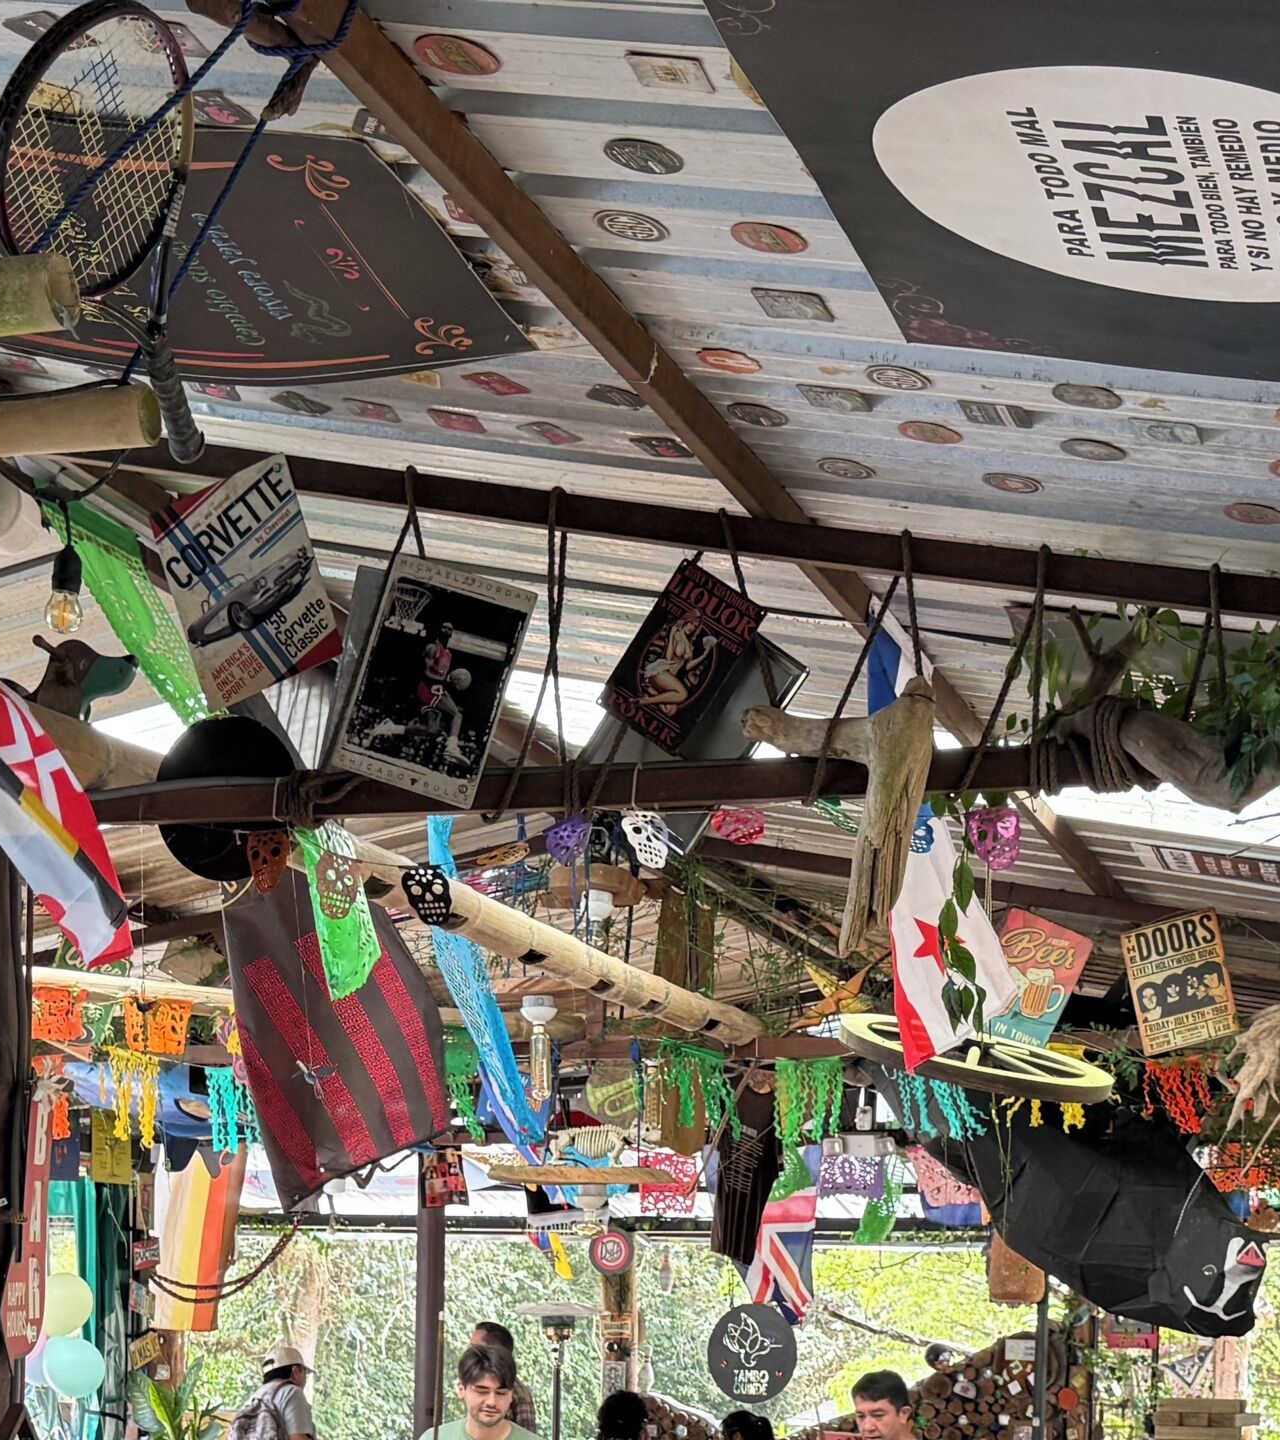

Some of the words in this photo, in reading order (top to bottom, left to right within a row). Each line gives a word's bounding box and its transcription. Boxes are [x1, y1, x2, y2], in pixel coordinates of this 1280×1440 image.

[1006, 107, 1049, 147] MAL
[1173, 116, 1211, 168] TAMBIÉN
[1212, 118, 1254, 181] REMEDIO
[1028, 153, 1074, 200] TODO
[1053, 115, 1209, 267] MEZCAL
[1196, 172, 1222, 201] BIEN,
[1205, 204, 1231, 235] TODO
[1232, 185, 1262, 215] HAY
[1052, 209, 1095, 257] PARA
[1241, 219, 1267, 241] NO
[1215, 239, 1238, 270] PARA
[1246, 245, 1271, 259] SI
[1250, 262, 1273, 271] Y
[166, 467, 294, 589] CORVETTE
[477, 579, 533, 604] JORDAN
[668, 573, 758, 641] LIQUOR
[275, 598, 326, 645] Corvette
[285, 618, 329, 659] Classic
[211, 642, 251, 681] AMERICA'S
[216, 672, 238, 693] ONLY
[237, 653, 258, 674] TRUE
[221, 679, 247, 703] SPORT
[247, 661, 265, 680] CAR
[607, 692, 677, 747] POKER
[339, 753, 406, 782] CHICAGO
[423, 779, 470, 804] BULLS
[1001, 927, 1077, 970] Beer
[1124, 934, 1138, 965] THE
[1135, 914, 1217, 962] DOORS
[1144, 1019, 1170, 1035] FRIDAY
[28, 1103, 48, 1320] BAR
[7, 1282, 27, 1307] HAPPY
[6, 1311, 27, 1338] HOURS
[733, 1370, 769, 1384] TAMBO
